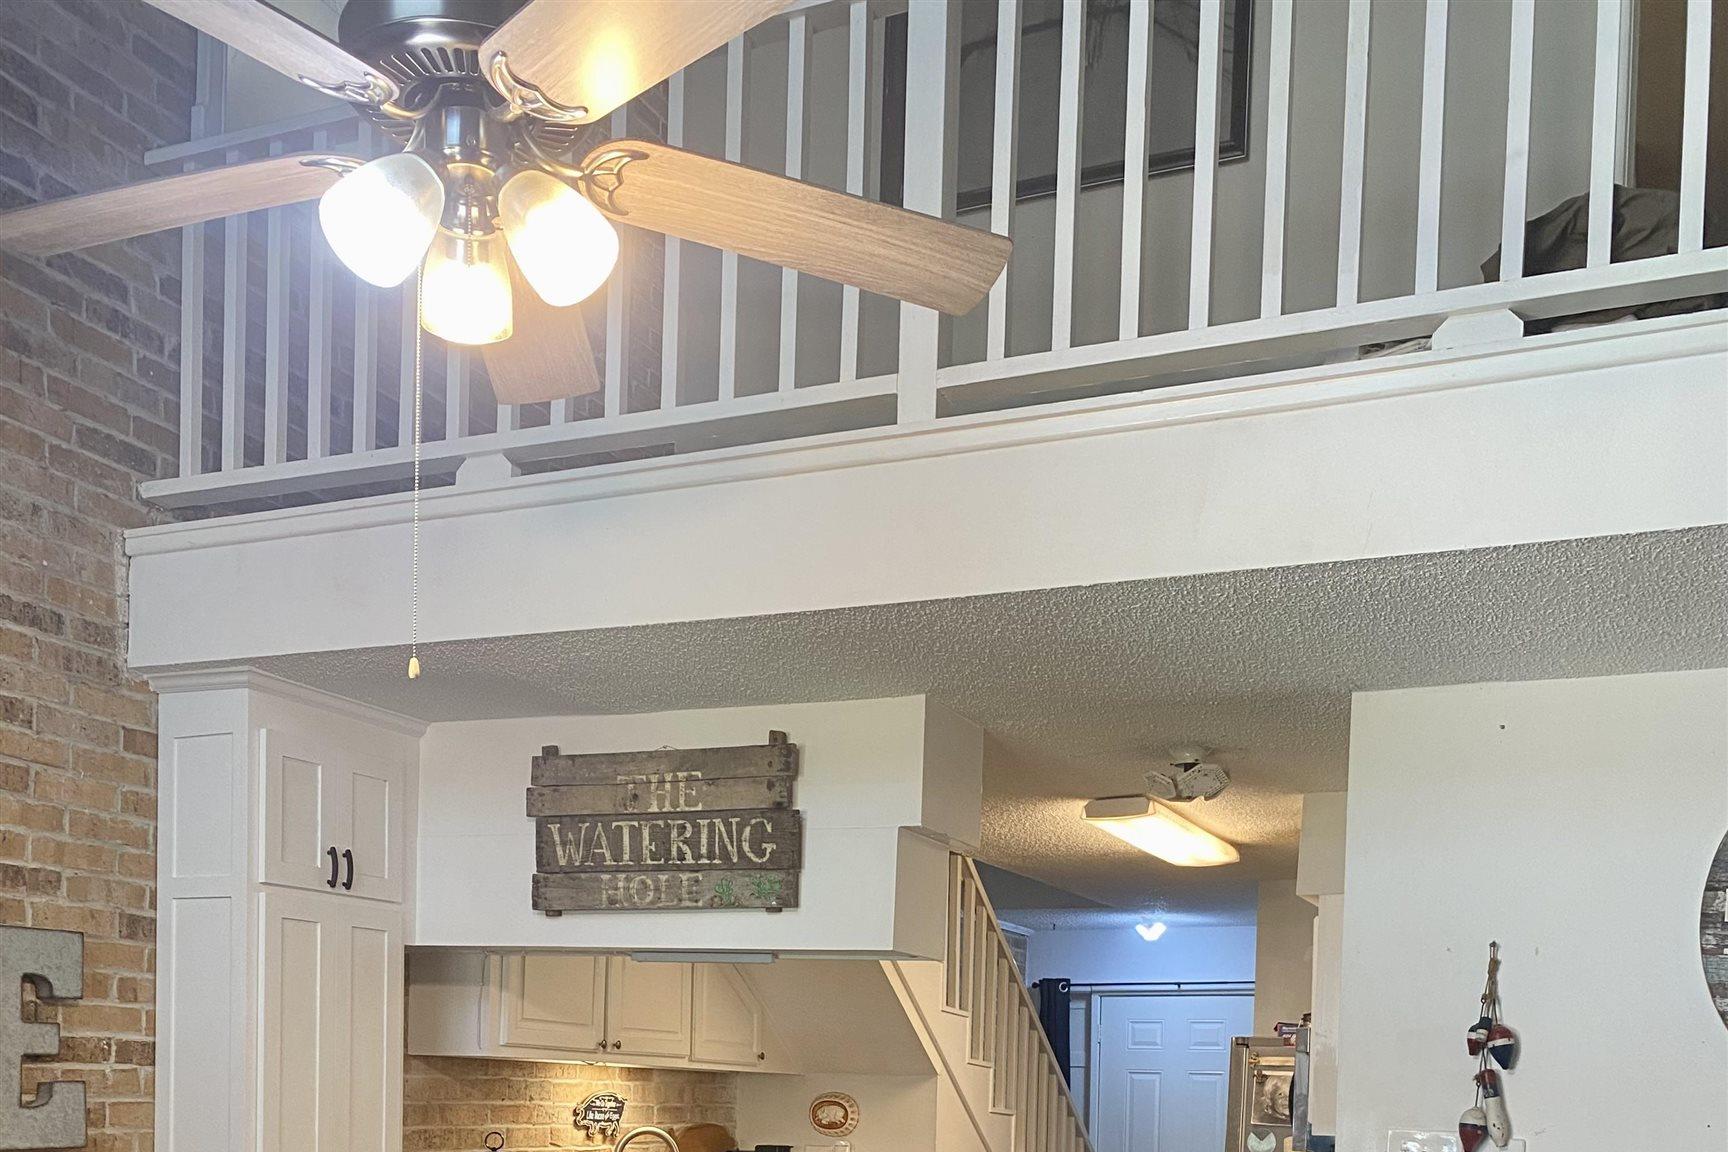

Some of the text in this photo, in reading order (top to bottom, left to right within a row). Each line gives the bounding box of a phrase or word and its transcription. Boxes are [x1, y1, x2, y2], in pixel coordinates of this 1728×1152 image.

[616, 771, 702, 813] THE
[548, 817, 777, 866] WATERING
[600, 873, 703, 907] HOLE
[0, 925, 87, 1150] E
